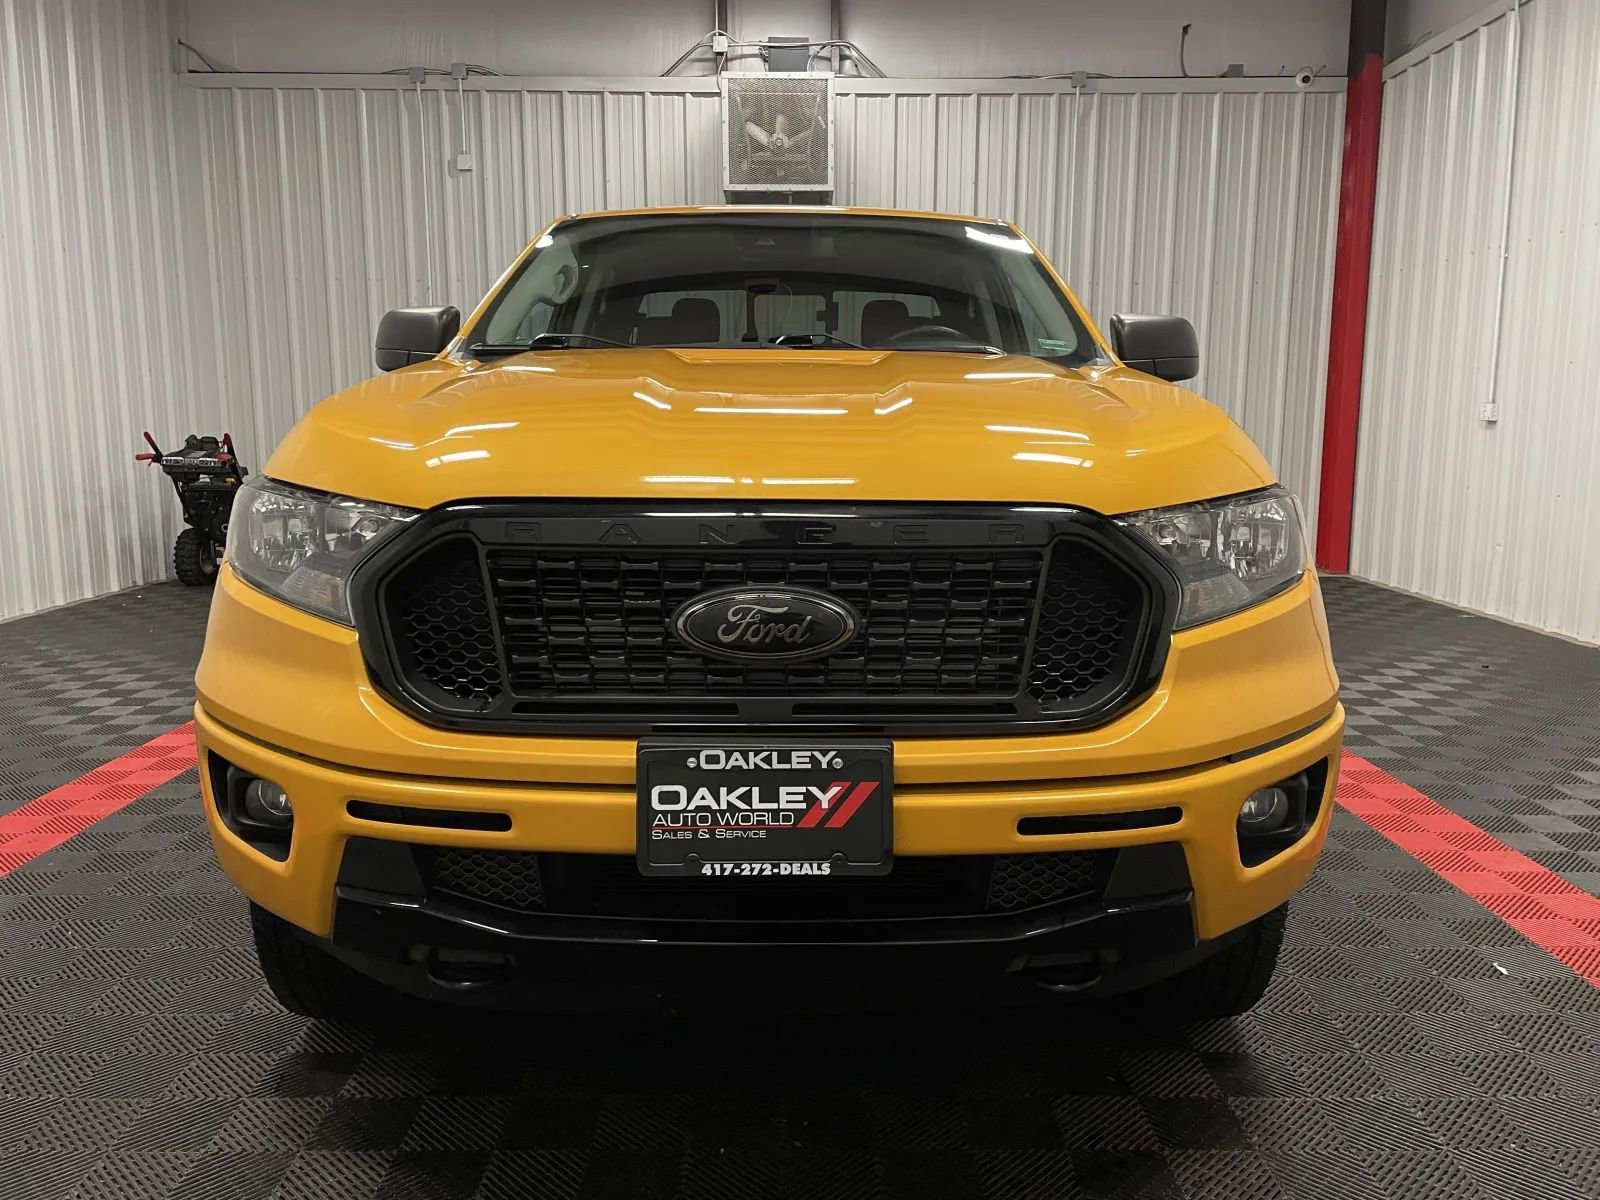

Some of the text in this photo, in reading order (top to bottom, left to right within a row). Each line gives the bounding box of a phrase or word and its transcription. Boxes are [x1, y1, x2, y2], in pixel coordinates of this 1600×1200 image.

[717, 604, 812, 643] Ford
[699, 749, 837, 769] OAKLEY
[651, 784, 843, 810] OAKLEY
[652, 811, 795, 827] AUTO WORLD
[652, 828, 767, 840] SALES & SERVICE
[701, 863, 831, 876] 417-272-DEALS
